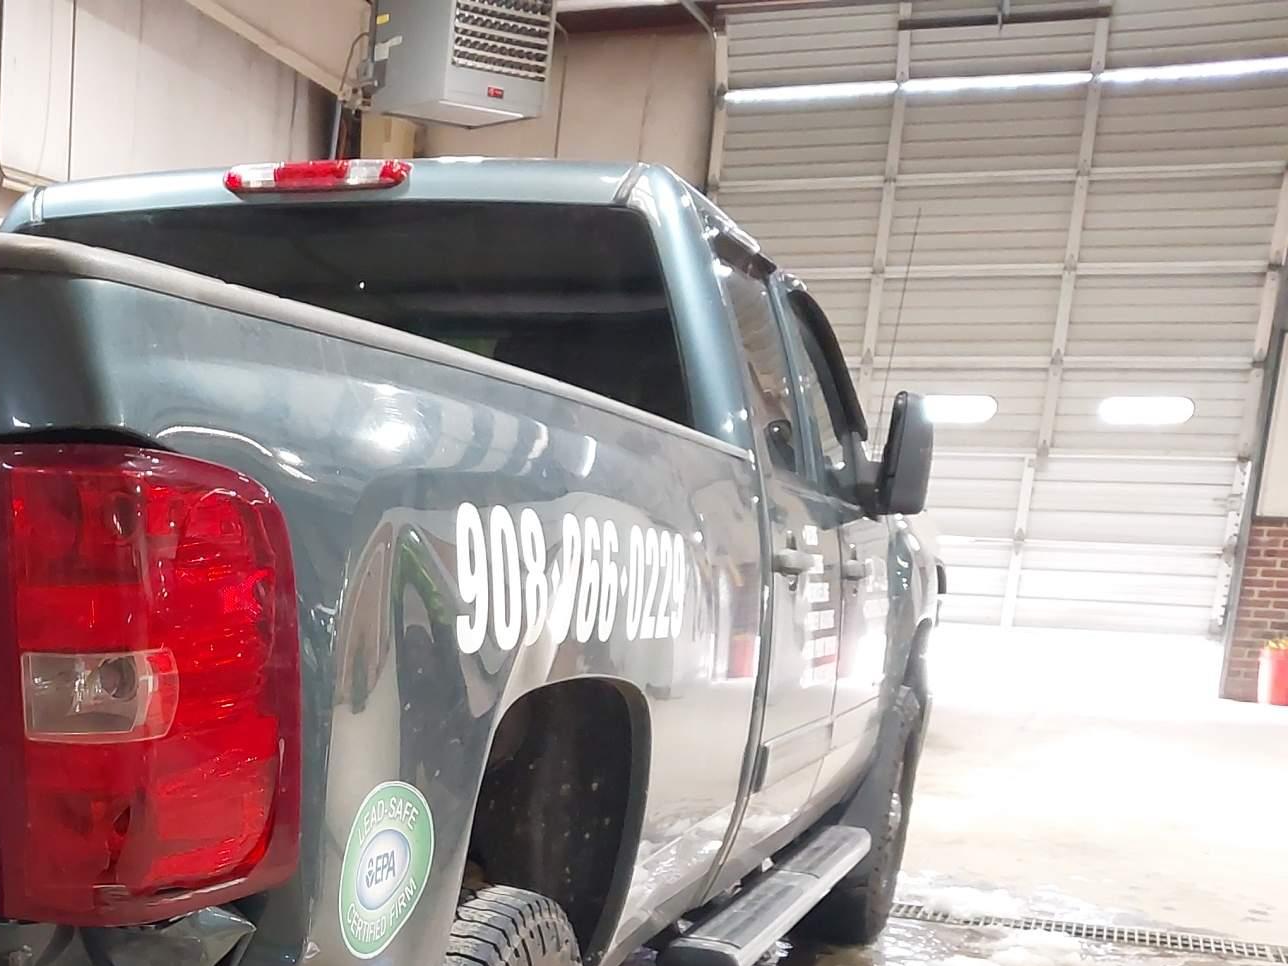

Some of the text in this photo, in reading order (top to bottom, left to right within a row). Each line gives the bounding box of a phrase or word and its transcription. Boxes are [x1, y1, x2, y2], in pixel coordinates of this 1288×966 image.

[356, 797, 419, 845] LEAD-SAFE
[374, 850, 397, 886] EPA
[346, 878, 417, 945] CERTIFIED FIRM
